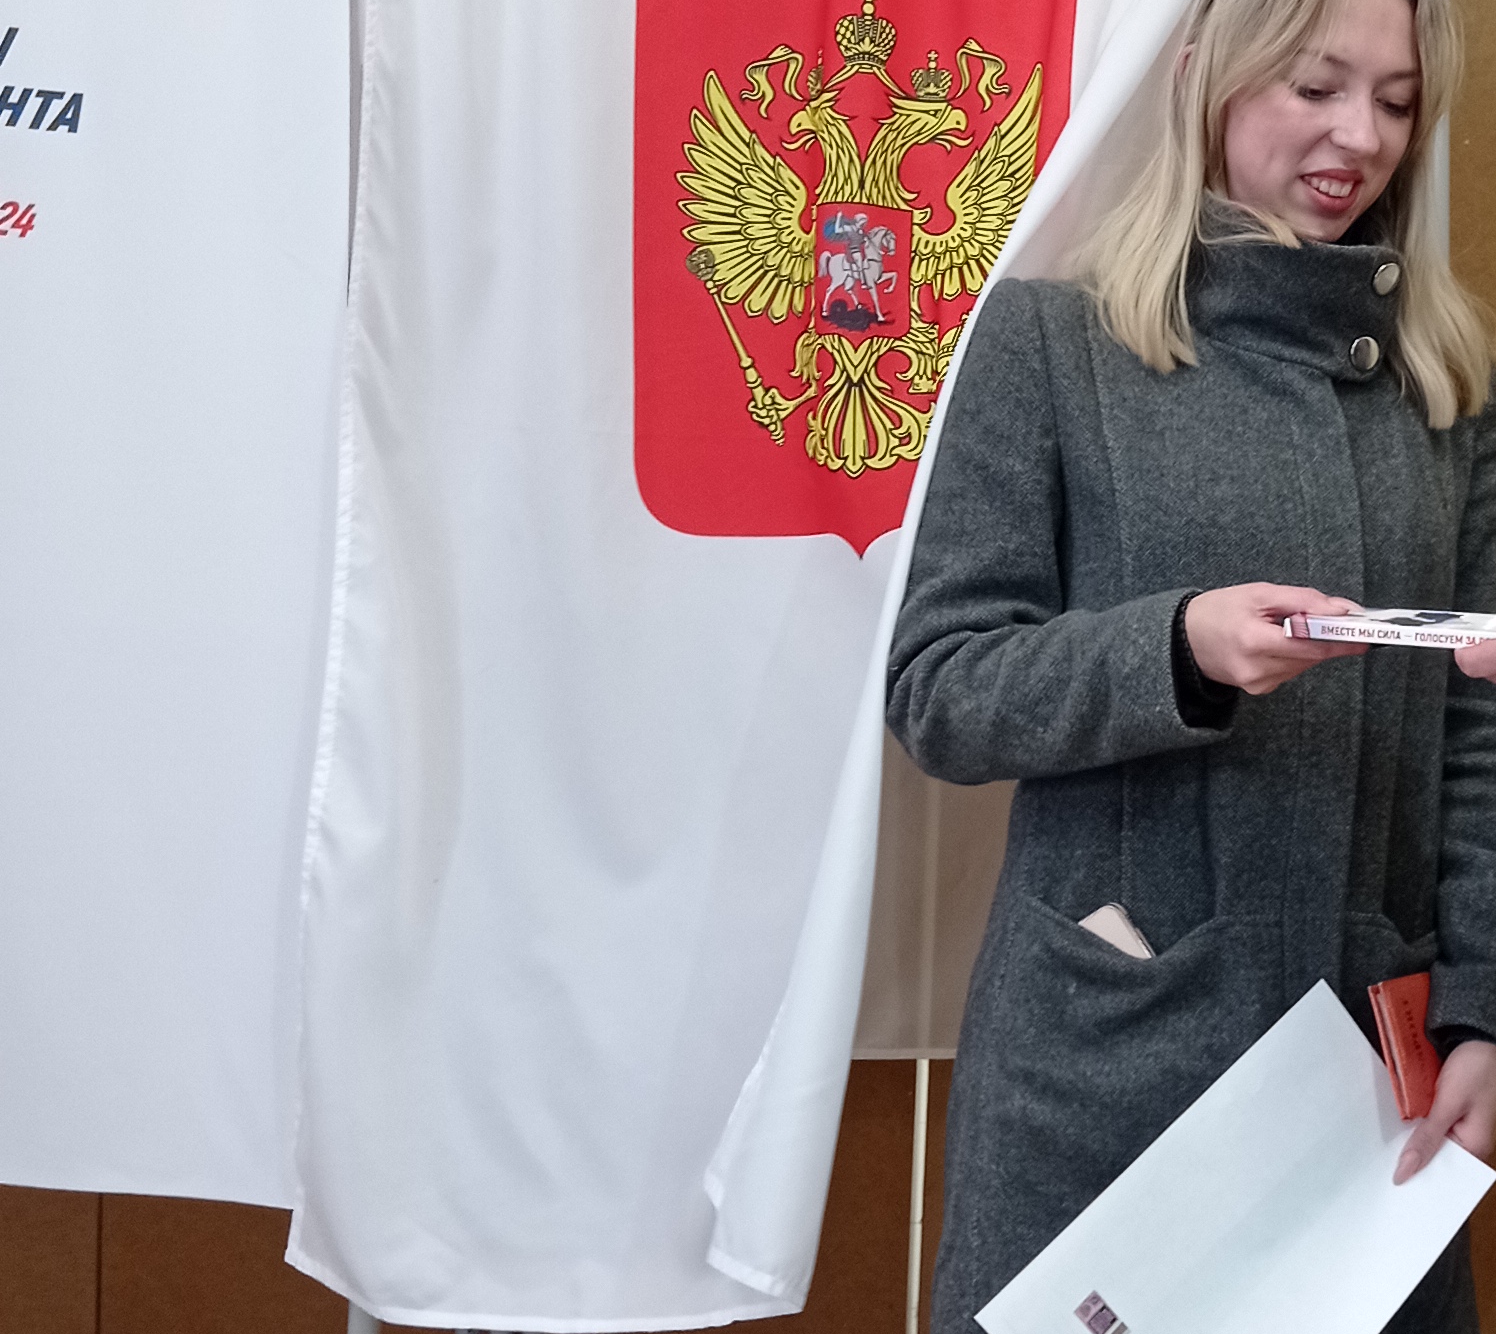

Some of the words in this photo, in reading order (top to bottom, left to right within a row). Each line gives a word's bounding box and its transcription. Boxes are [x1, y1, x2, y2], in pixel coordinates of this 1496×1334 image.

[1320, 625, 1356, 637] ВМЕСТЕ
[1358, 628, 1376, 639] МЫ
[1377, 630, 1402, 640] СИЛА
[1414, 632, 1464, 645] ГОЛОСУЕМ
